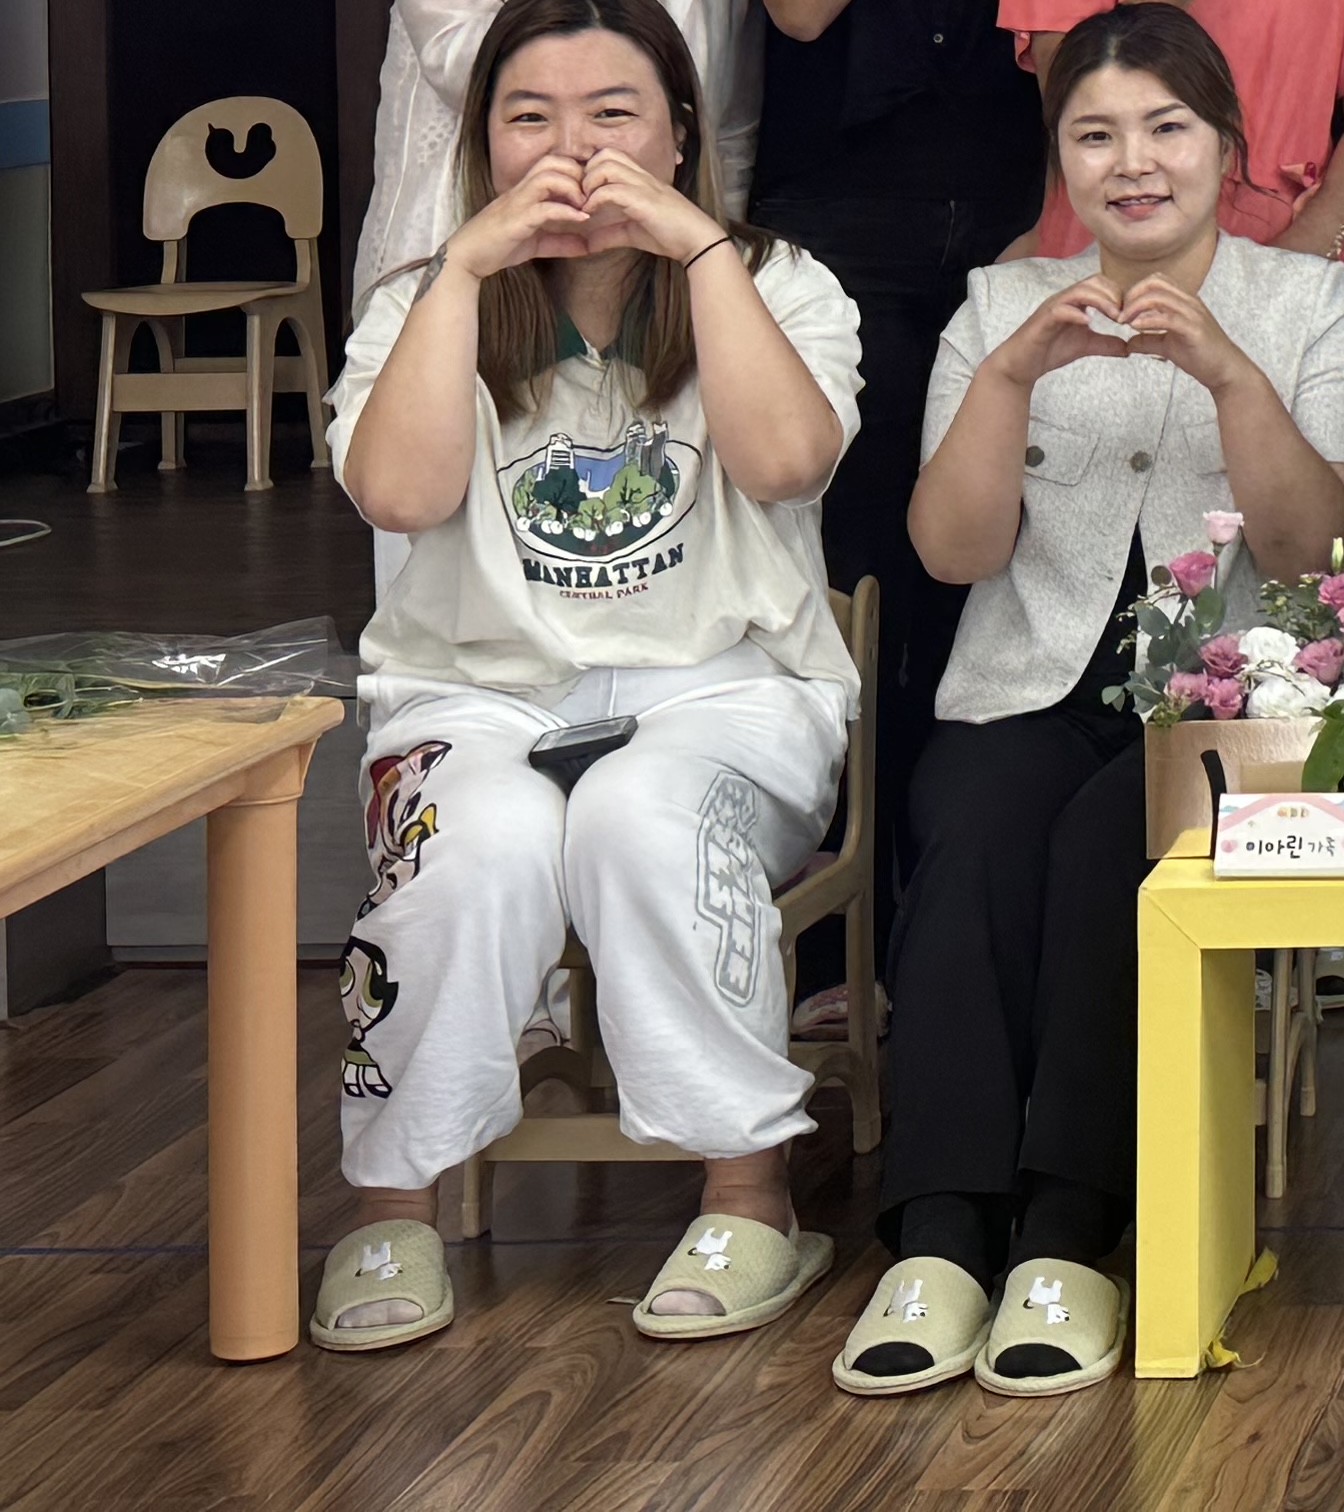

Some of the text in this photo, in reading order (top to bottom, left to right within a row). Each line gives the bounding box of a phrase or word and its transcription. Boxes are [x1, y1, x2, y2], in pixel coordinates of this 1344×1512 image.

[522, 543, 685, 588] MANHATTAN
[617, 582, 649, 599] PARK
[1246, 835, 1303, 859] 이아린
